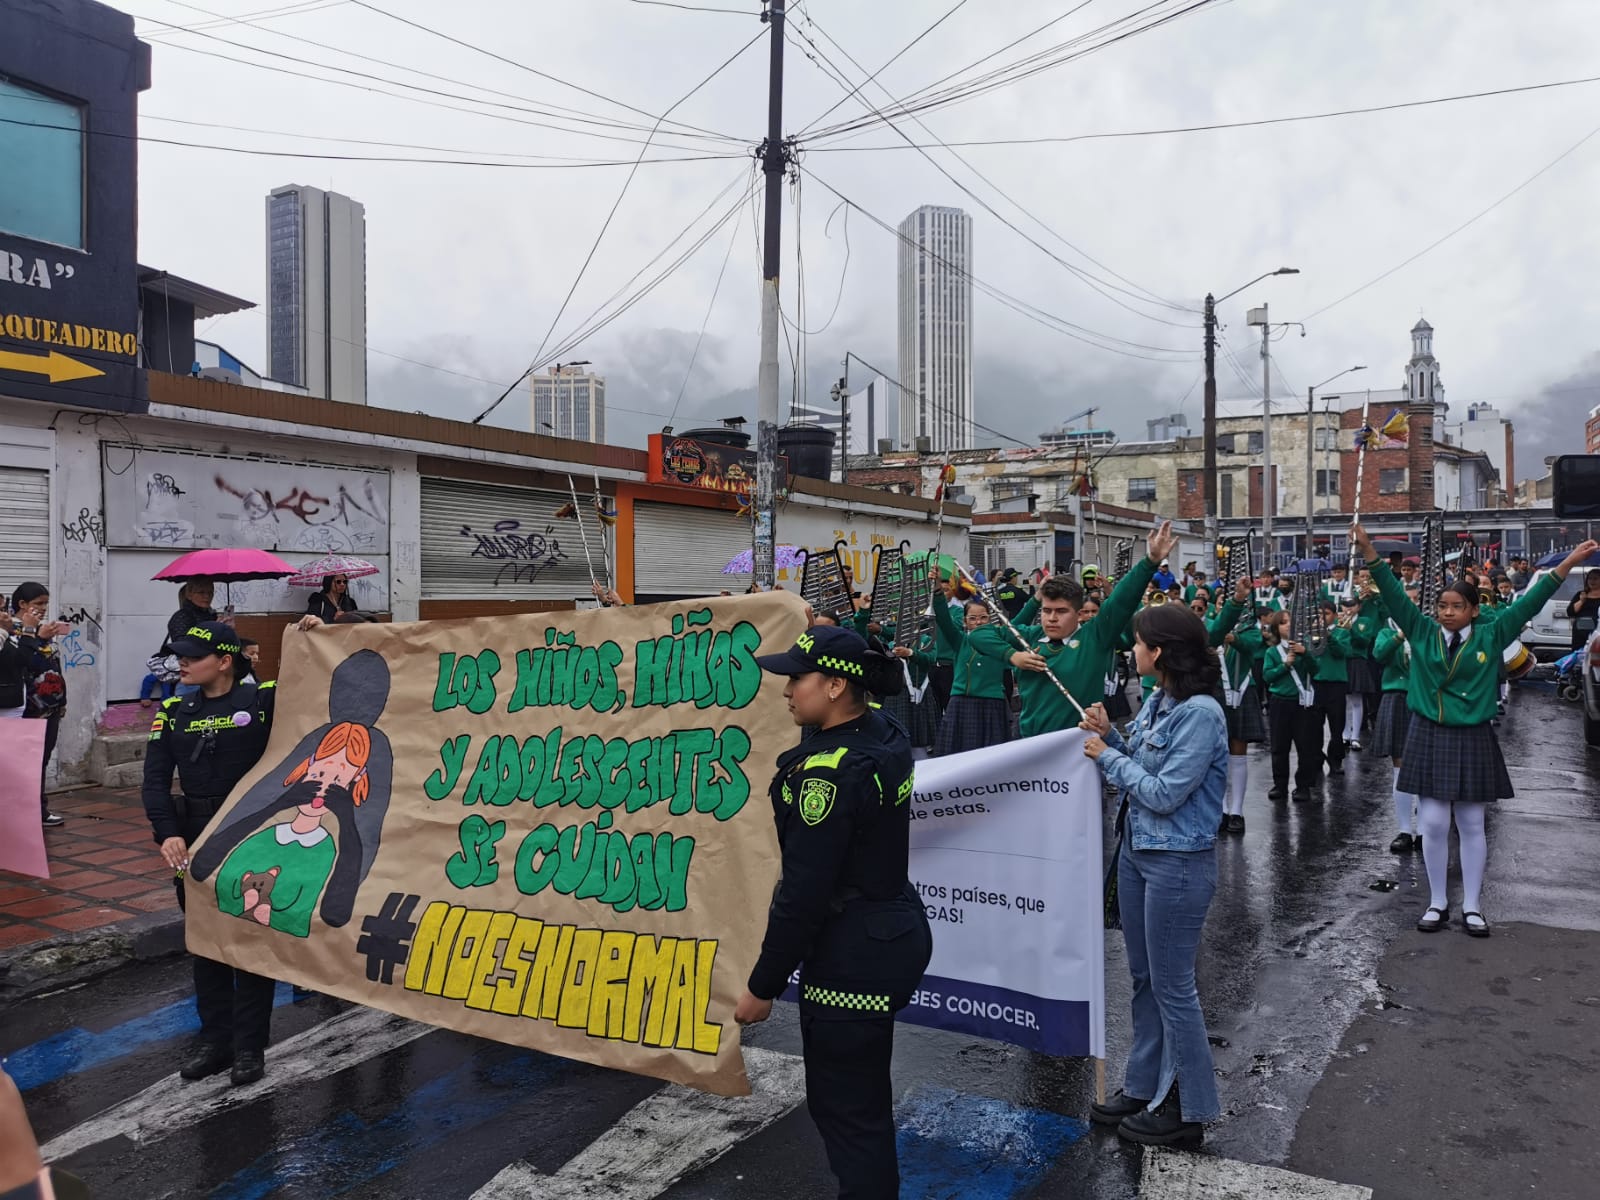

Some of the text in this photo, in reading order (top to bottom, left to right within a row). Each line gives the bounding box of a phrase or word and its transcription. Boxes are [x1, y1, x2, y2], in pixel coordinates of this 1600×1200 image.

[432, 608, 762, 714] LOS NIÑOS, NIÑAS
[424, 725, 751, 821] Y ADOLESCENTES
[913, 777, 1069, 804] tus documentos
[933, 803, 991, 818] estas.
[445, 810, 695, 912] SE CUIDAN
[916, 881, 1046, 915] tros países, que
[356, 892, 723, 1055] #NOESNORMAL
[946, 995, 1040, 1030] CONOCER.
